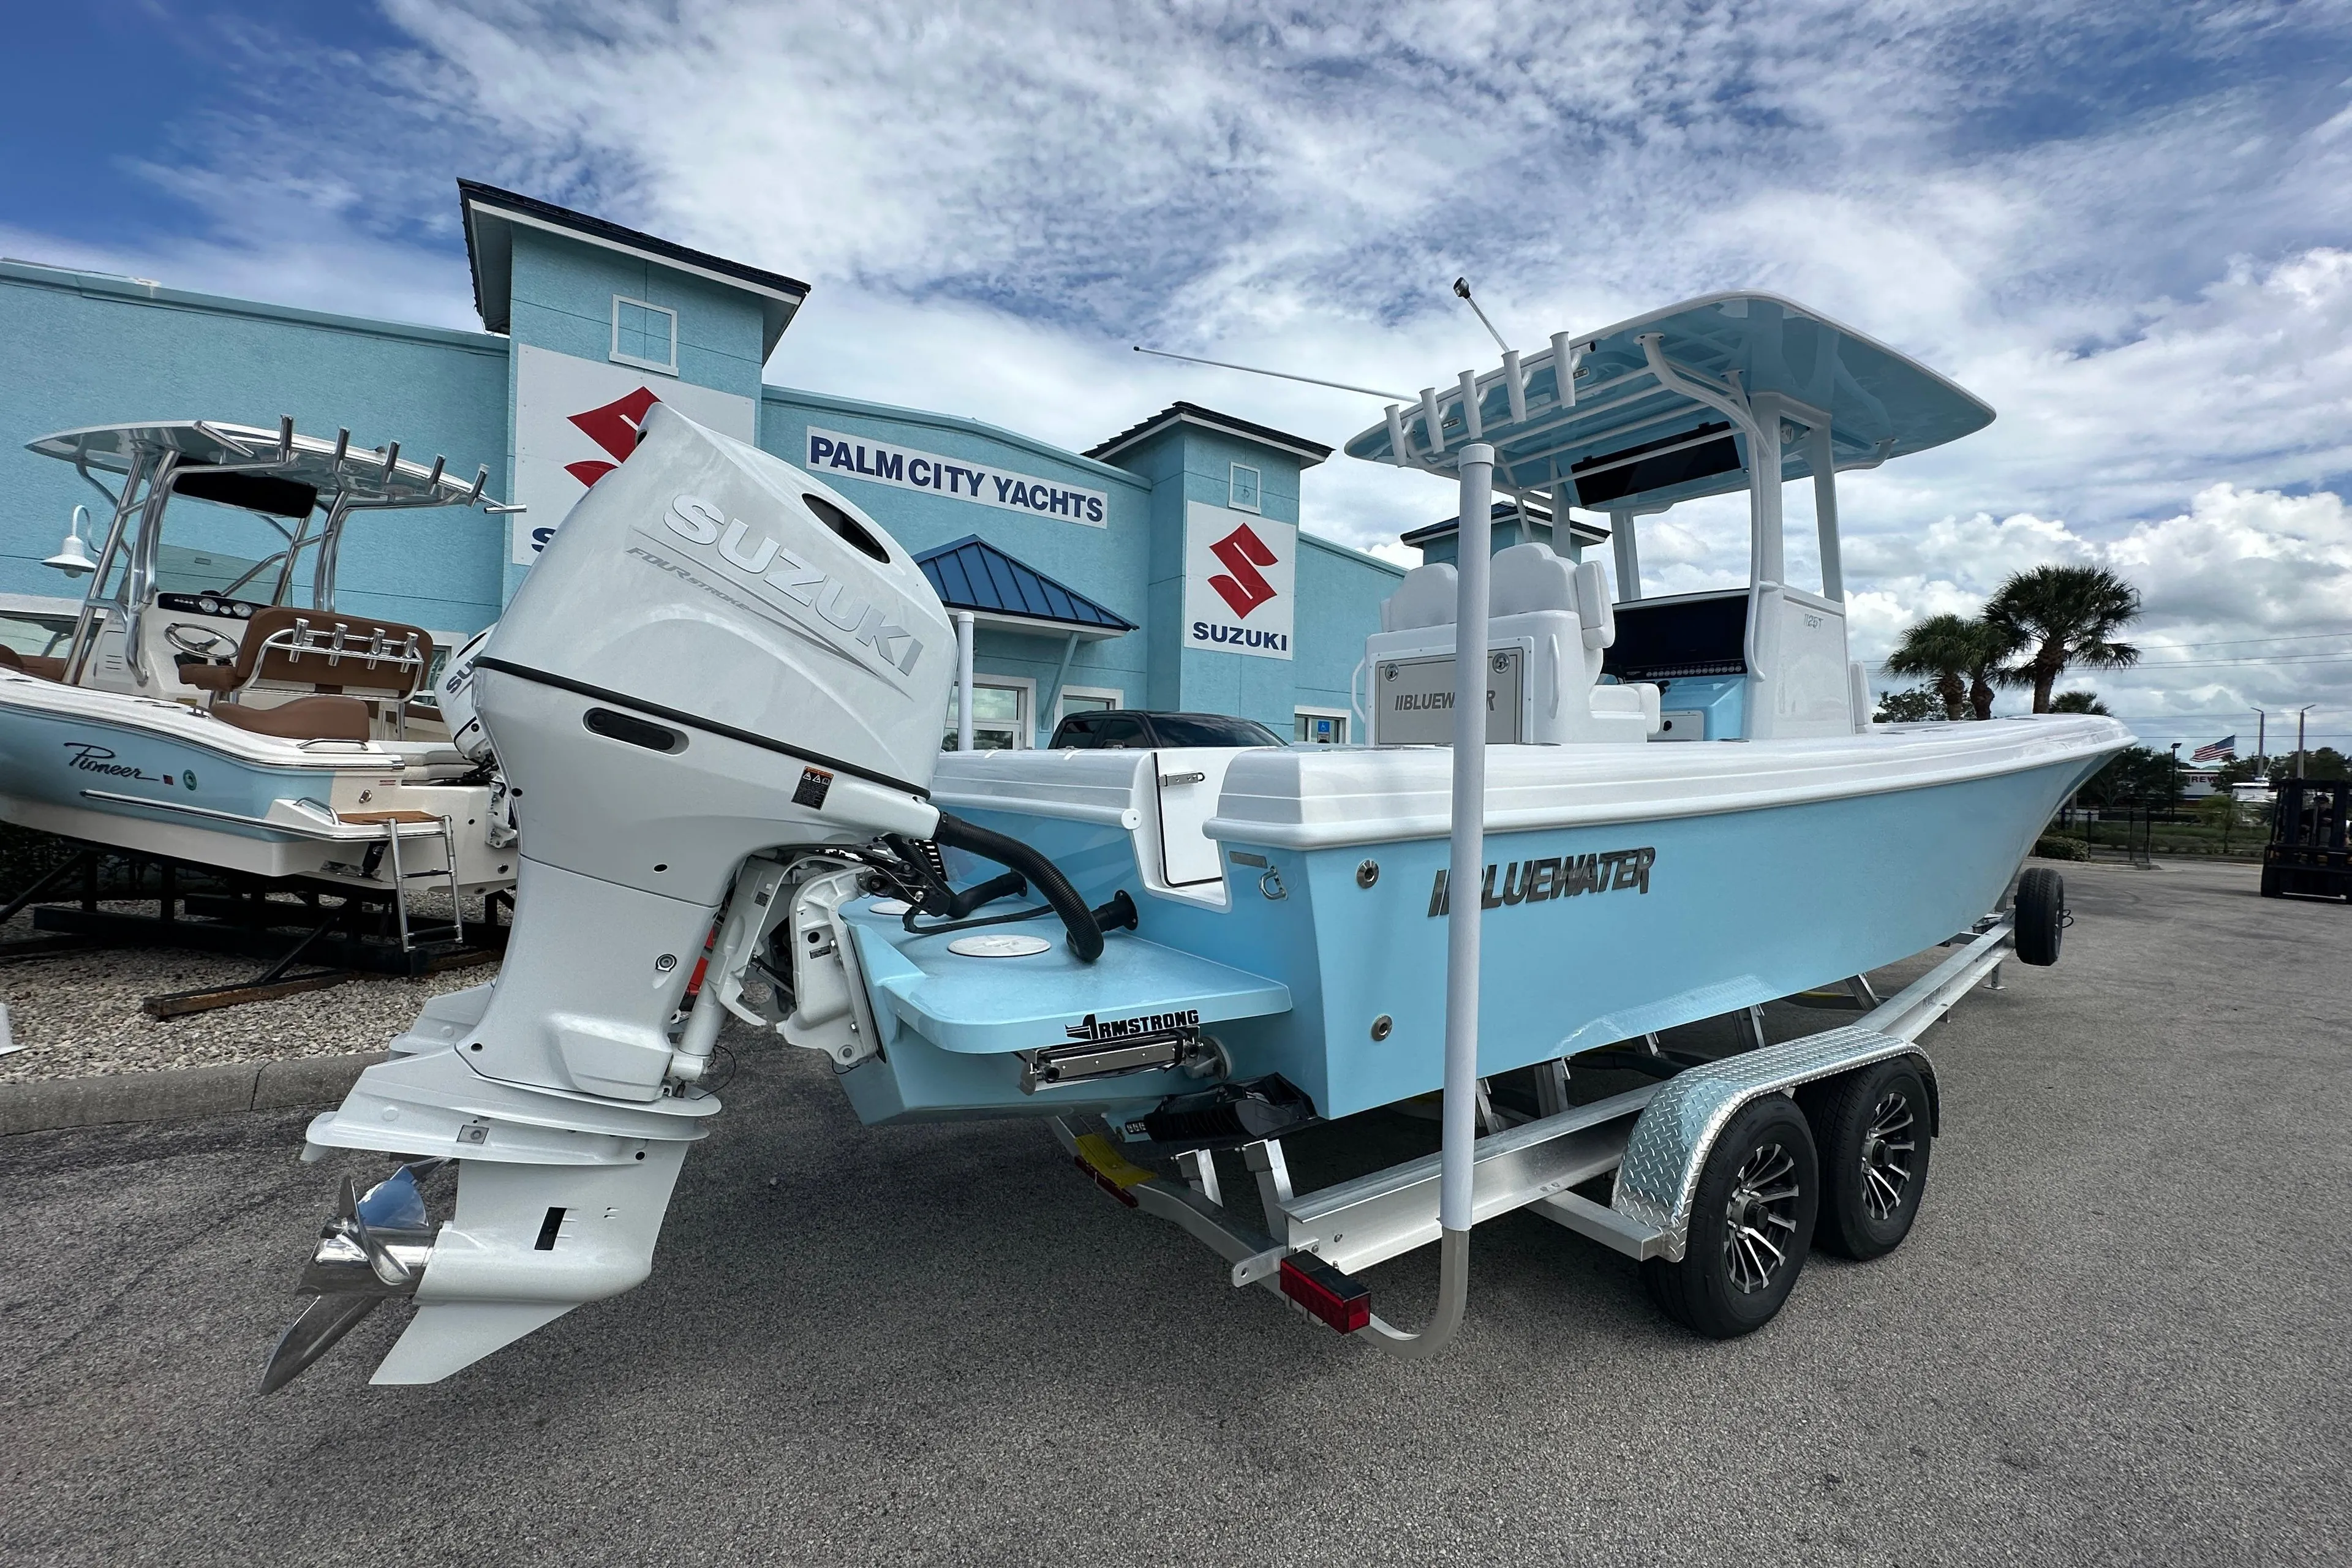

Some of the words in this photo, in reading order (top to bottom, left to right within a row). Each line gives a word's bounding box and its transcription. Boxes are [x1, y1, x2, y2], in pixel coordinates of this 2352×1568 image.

[810, 435, 903, 481] PALM
[908, 458, 986, 497] CITY
[992, 475, 1104, 522] YACHTS
[663, 494, 924, 677] SUZUKI
[1193, 622, 1287, 651] SUZUKI
[64, 742, 160, 782] Pioneer
[1065, 1009, 1199, 1039] ARMSTRONG
